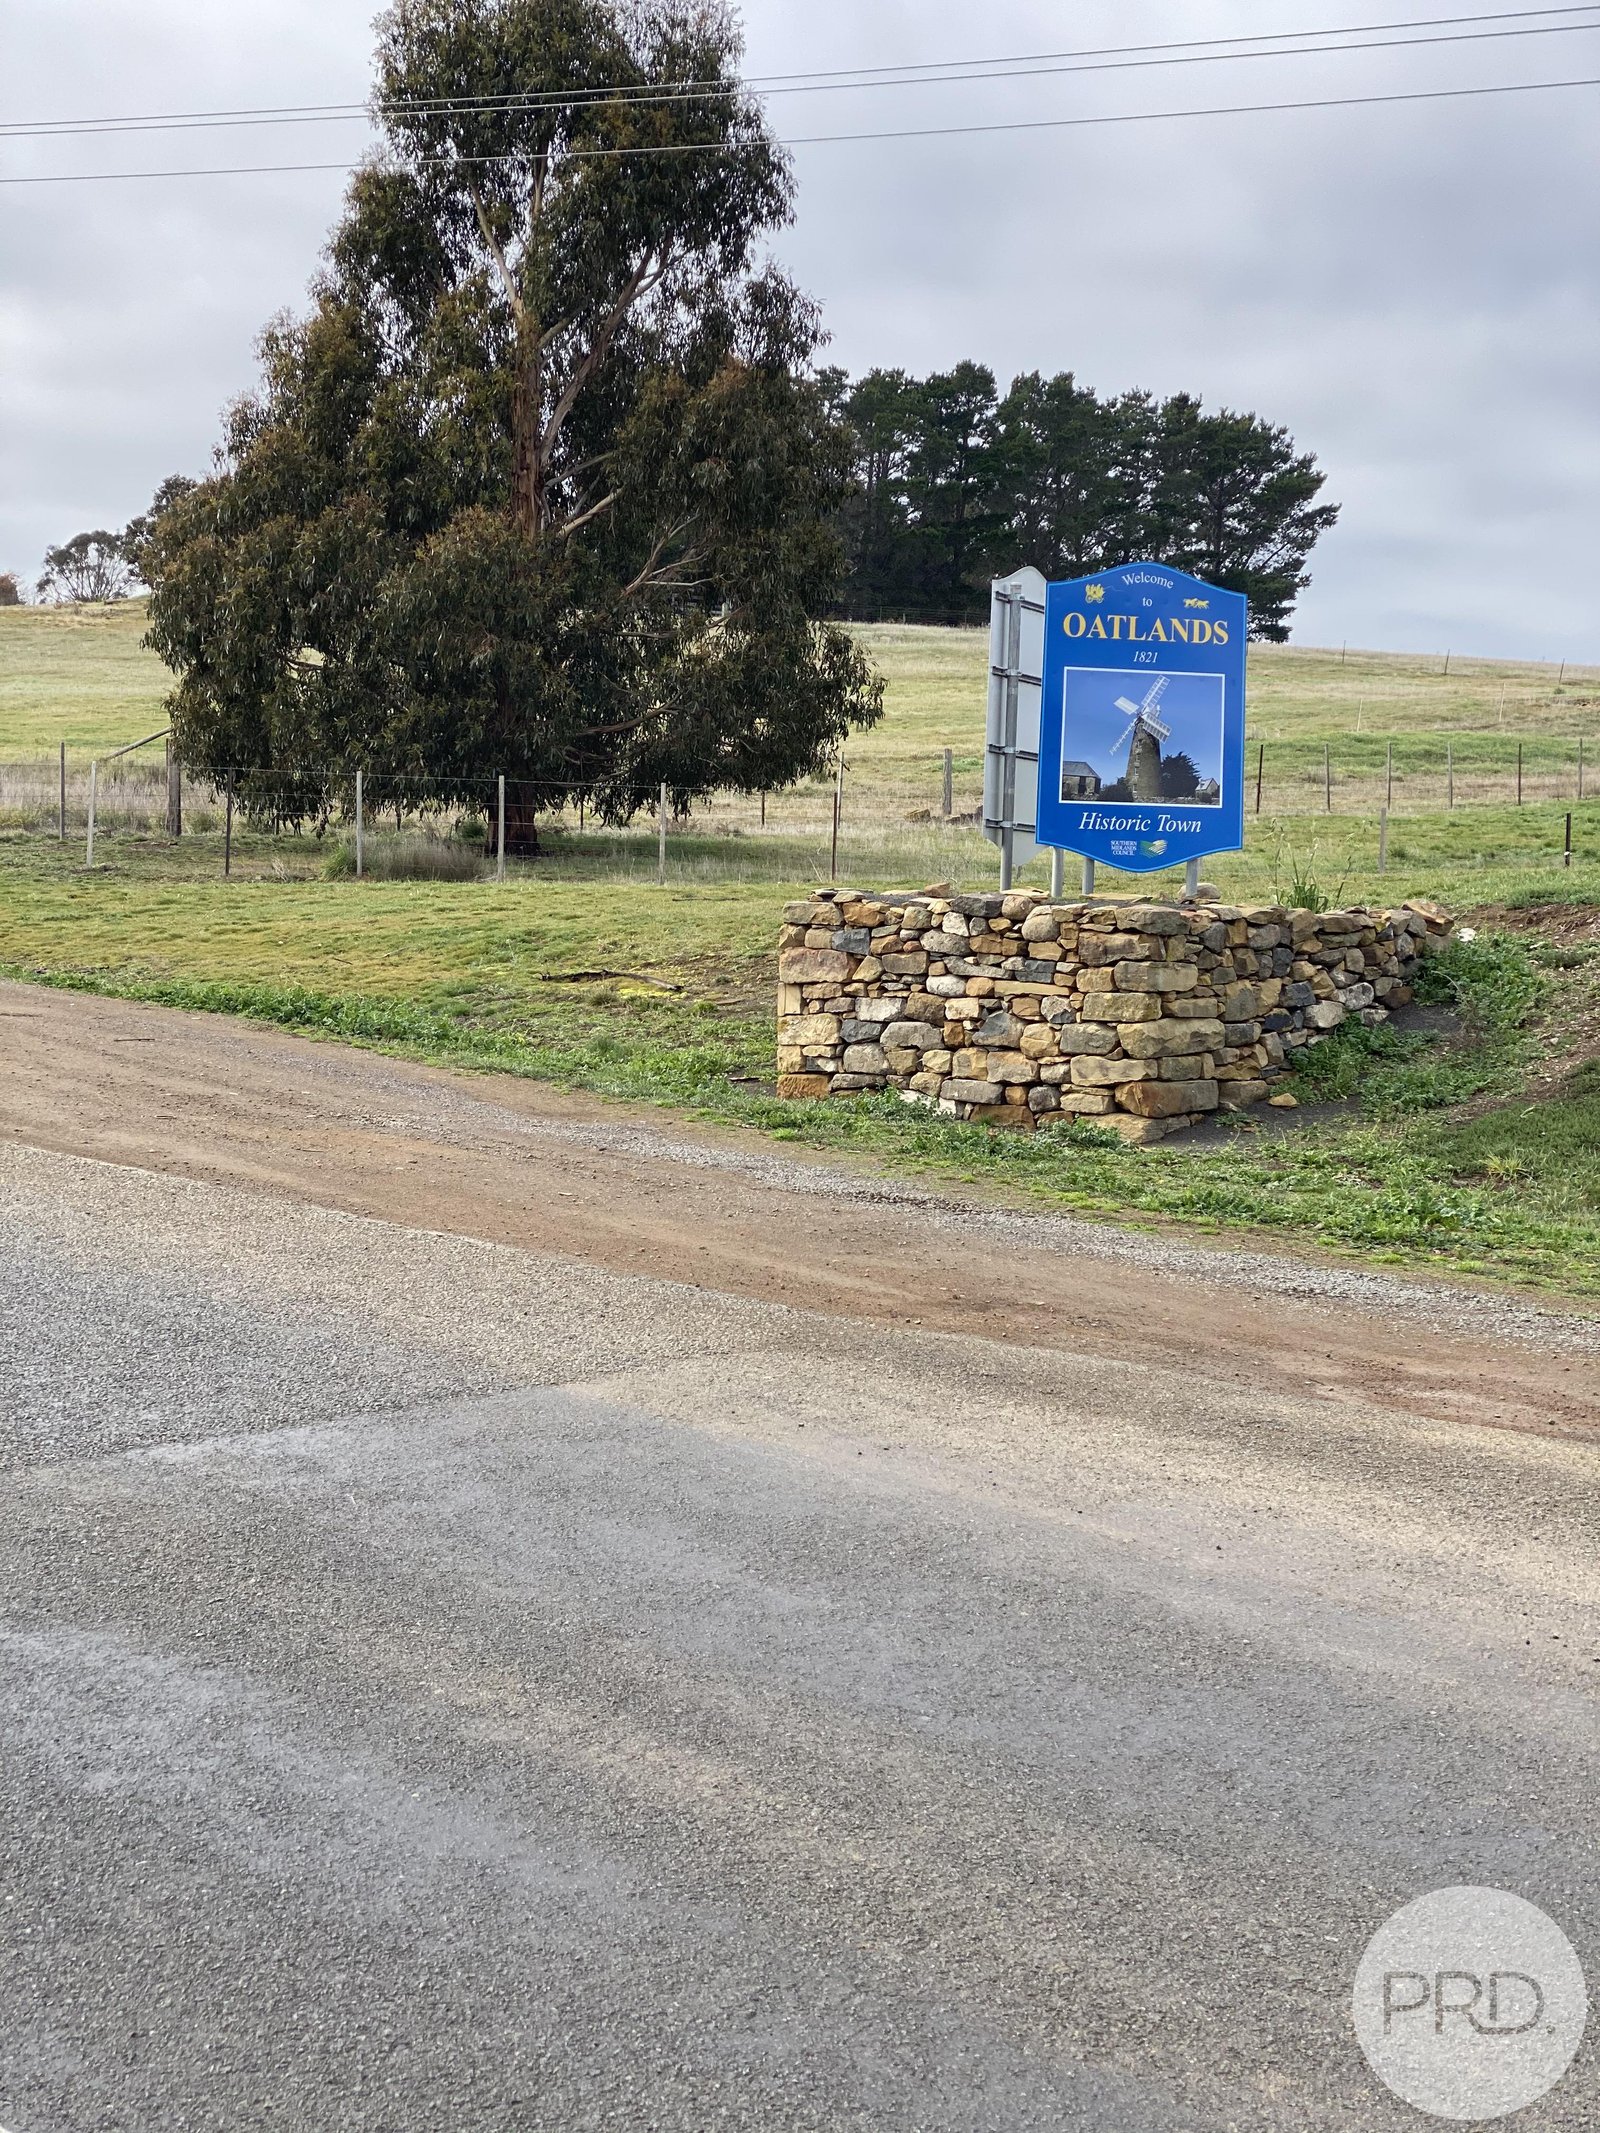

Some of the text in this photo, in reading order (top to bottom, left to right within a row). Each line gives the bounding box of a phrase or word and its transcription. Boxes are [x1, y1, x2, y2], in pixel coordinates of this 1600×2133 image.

[1121, 571, 1174, 589] Welcome
[1142, 596, 1153, 607] to
[1063, 612, 1229, 646] OATLANDS
[1133, 651, 1158, 663] 1821
[1078, 812, 1202, 833] Historic Town
